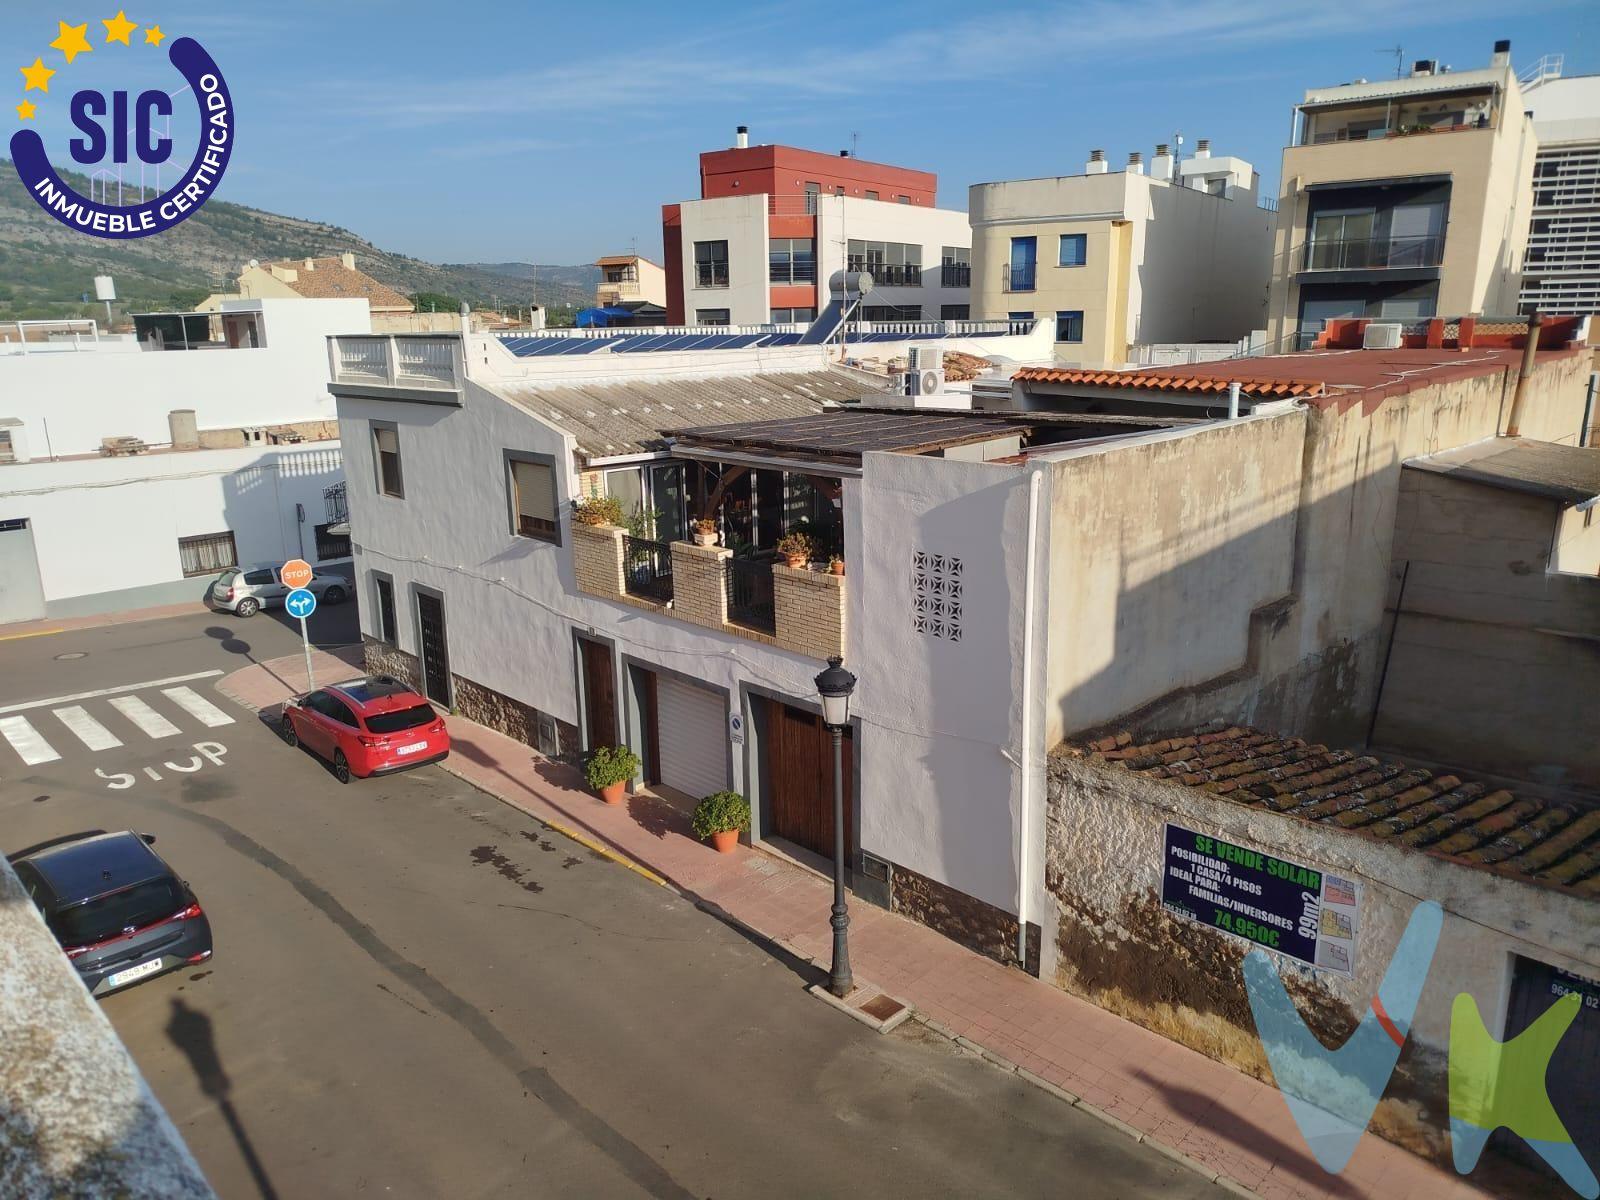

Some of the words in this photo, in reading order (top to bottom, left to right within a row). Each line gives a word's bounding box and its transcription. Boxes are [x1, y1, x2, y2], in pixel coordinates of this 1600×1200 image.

[285, 570, 309, 579] STOP
[1171, 845, 1231, 874] POSIBILIDAD:
[1195, 835, 1214, 855] SE
[1216, 841, 1264, 872] VENDE
[1267, 858, 1320, 890] SOLAR
[1169, 866, 1194, 883] IDEAL
[1194, 874, 1221, 893] PARA:
[1190, 863, 1195, 873] 1
[1196, 865, 1232, 886] CASA/4
[1233, 877, 1262, 896] PISOS
[1188, 884, 1294, 931] FAMILIAS/INVERSORES
[1298, 891, 1320, 940] 99m2
[1214, 908, 1280, 947] 74.950€
[1551, 983, 1569, 998] 964
[1586, 995, 1599, 1009] 02
